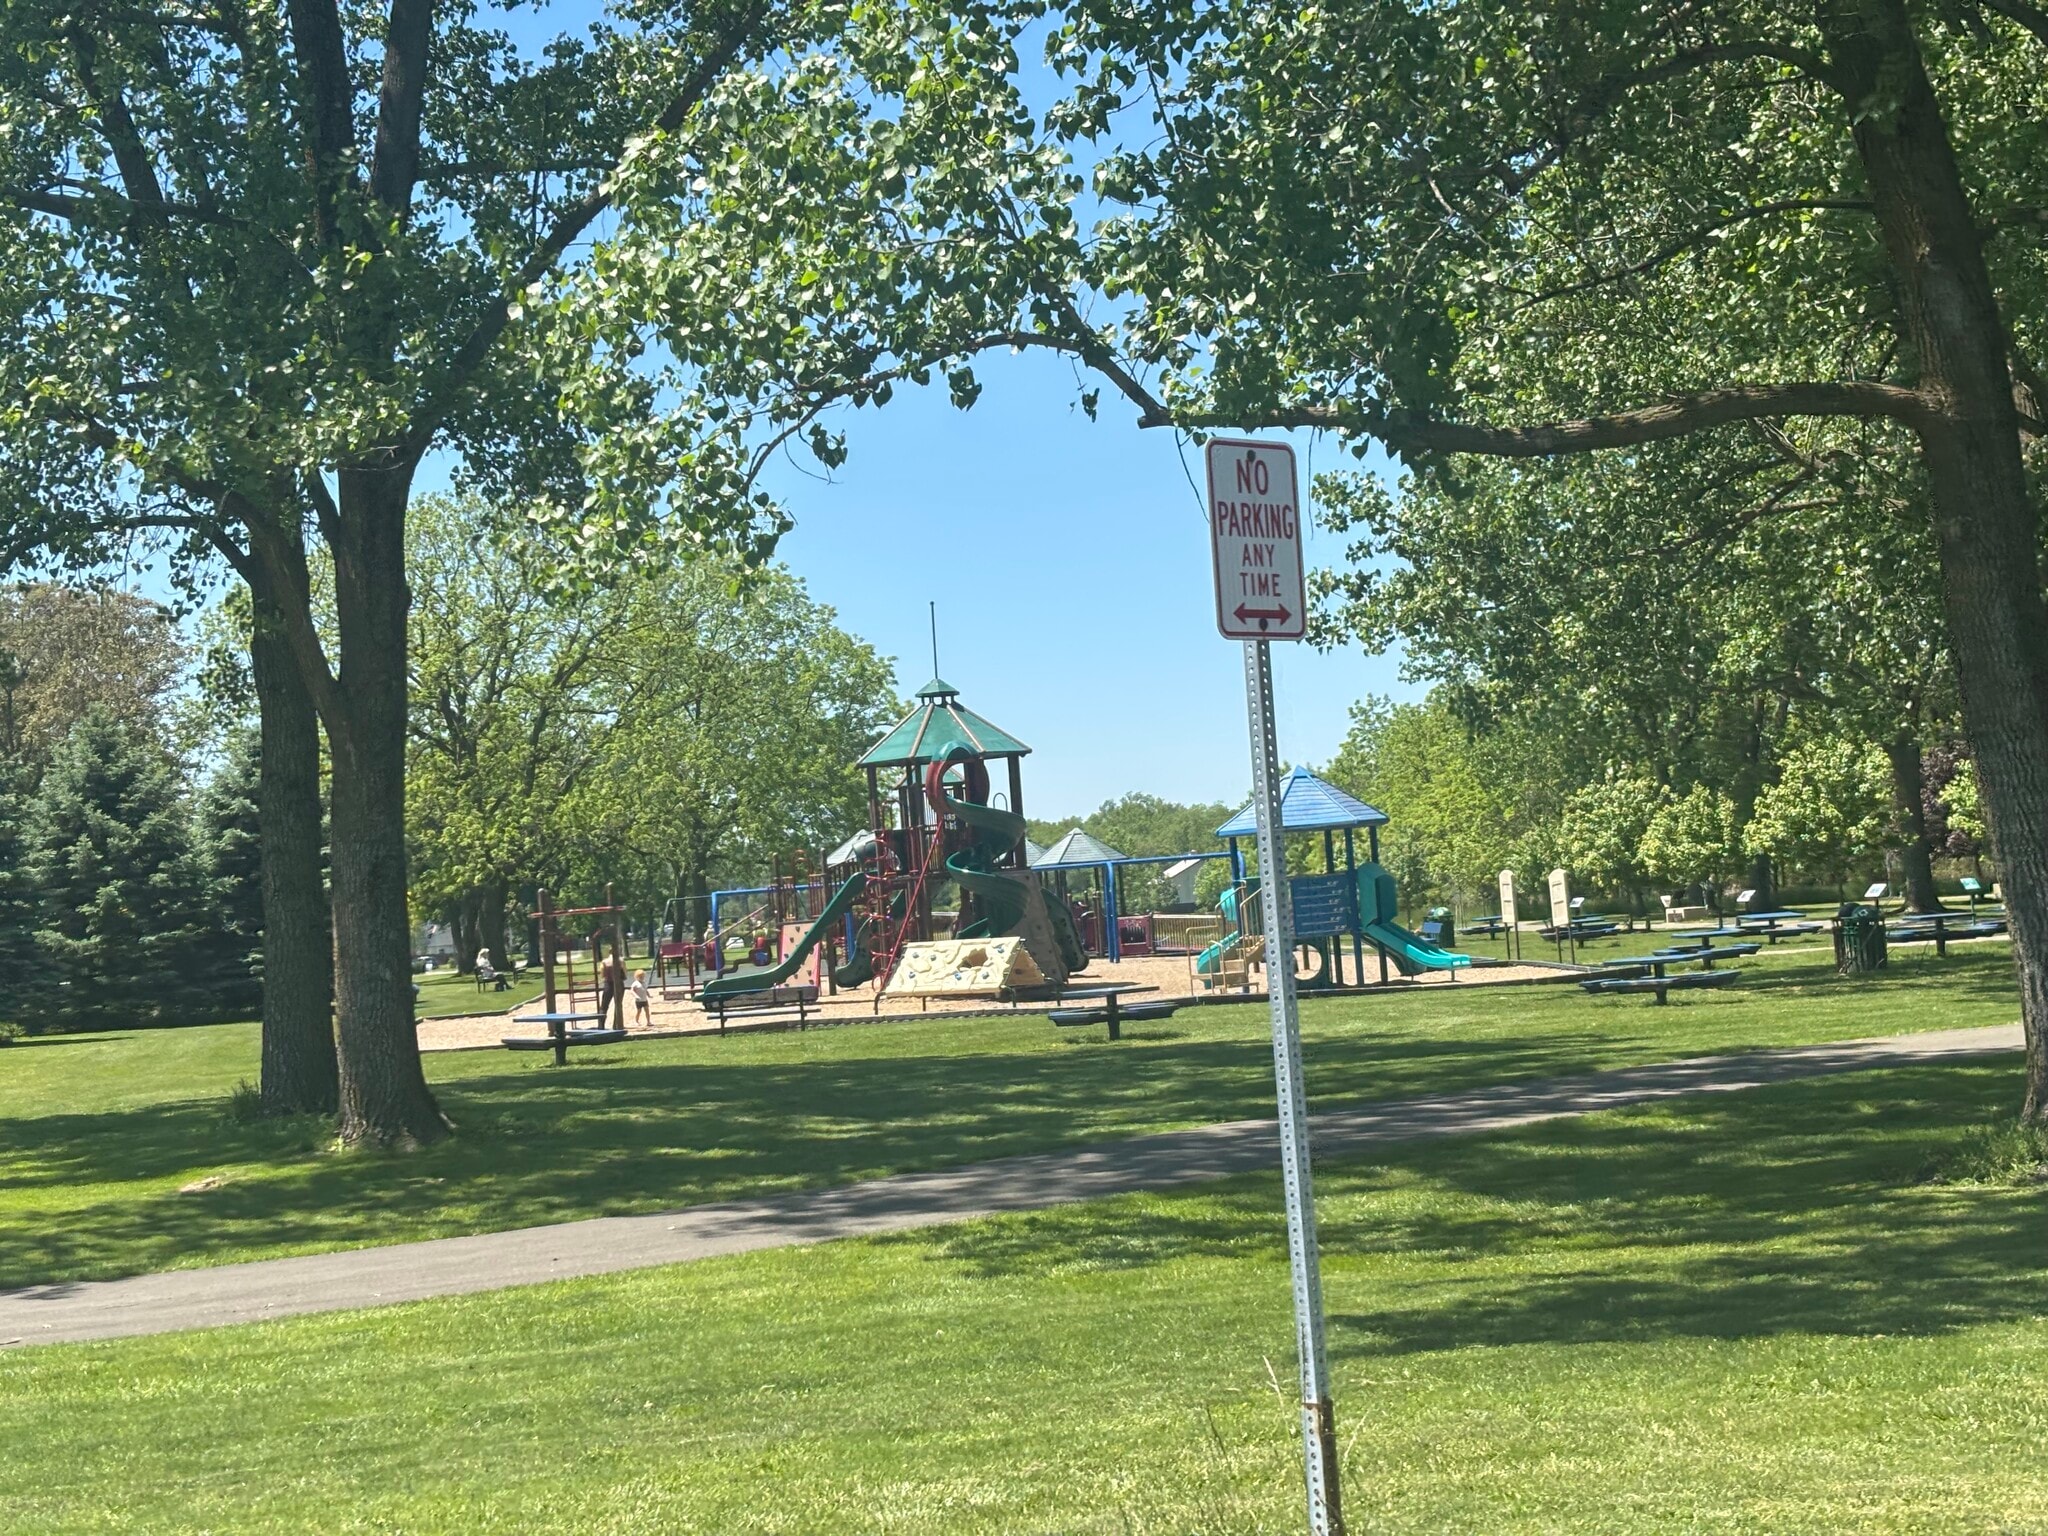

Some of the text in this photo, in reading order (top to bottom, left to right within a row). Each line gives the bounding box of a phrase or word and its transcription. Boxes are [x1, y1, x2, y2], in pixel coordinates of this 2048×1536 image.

[1236, 459, 1269, 495] NO
[1217, 501, 1294, 539] PARKING
[1242, 543, 1275, 567] ANY
[1239, 572, 1282, 597] TIME
